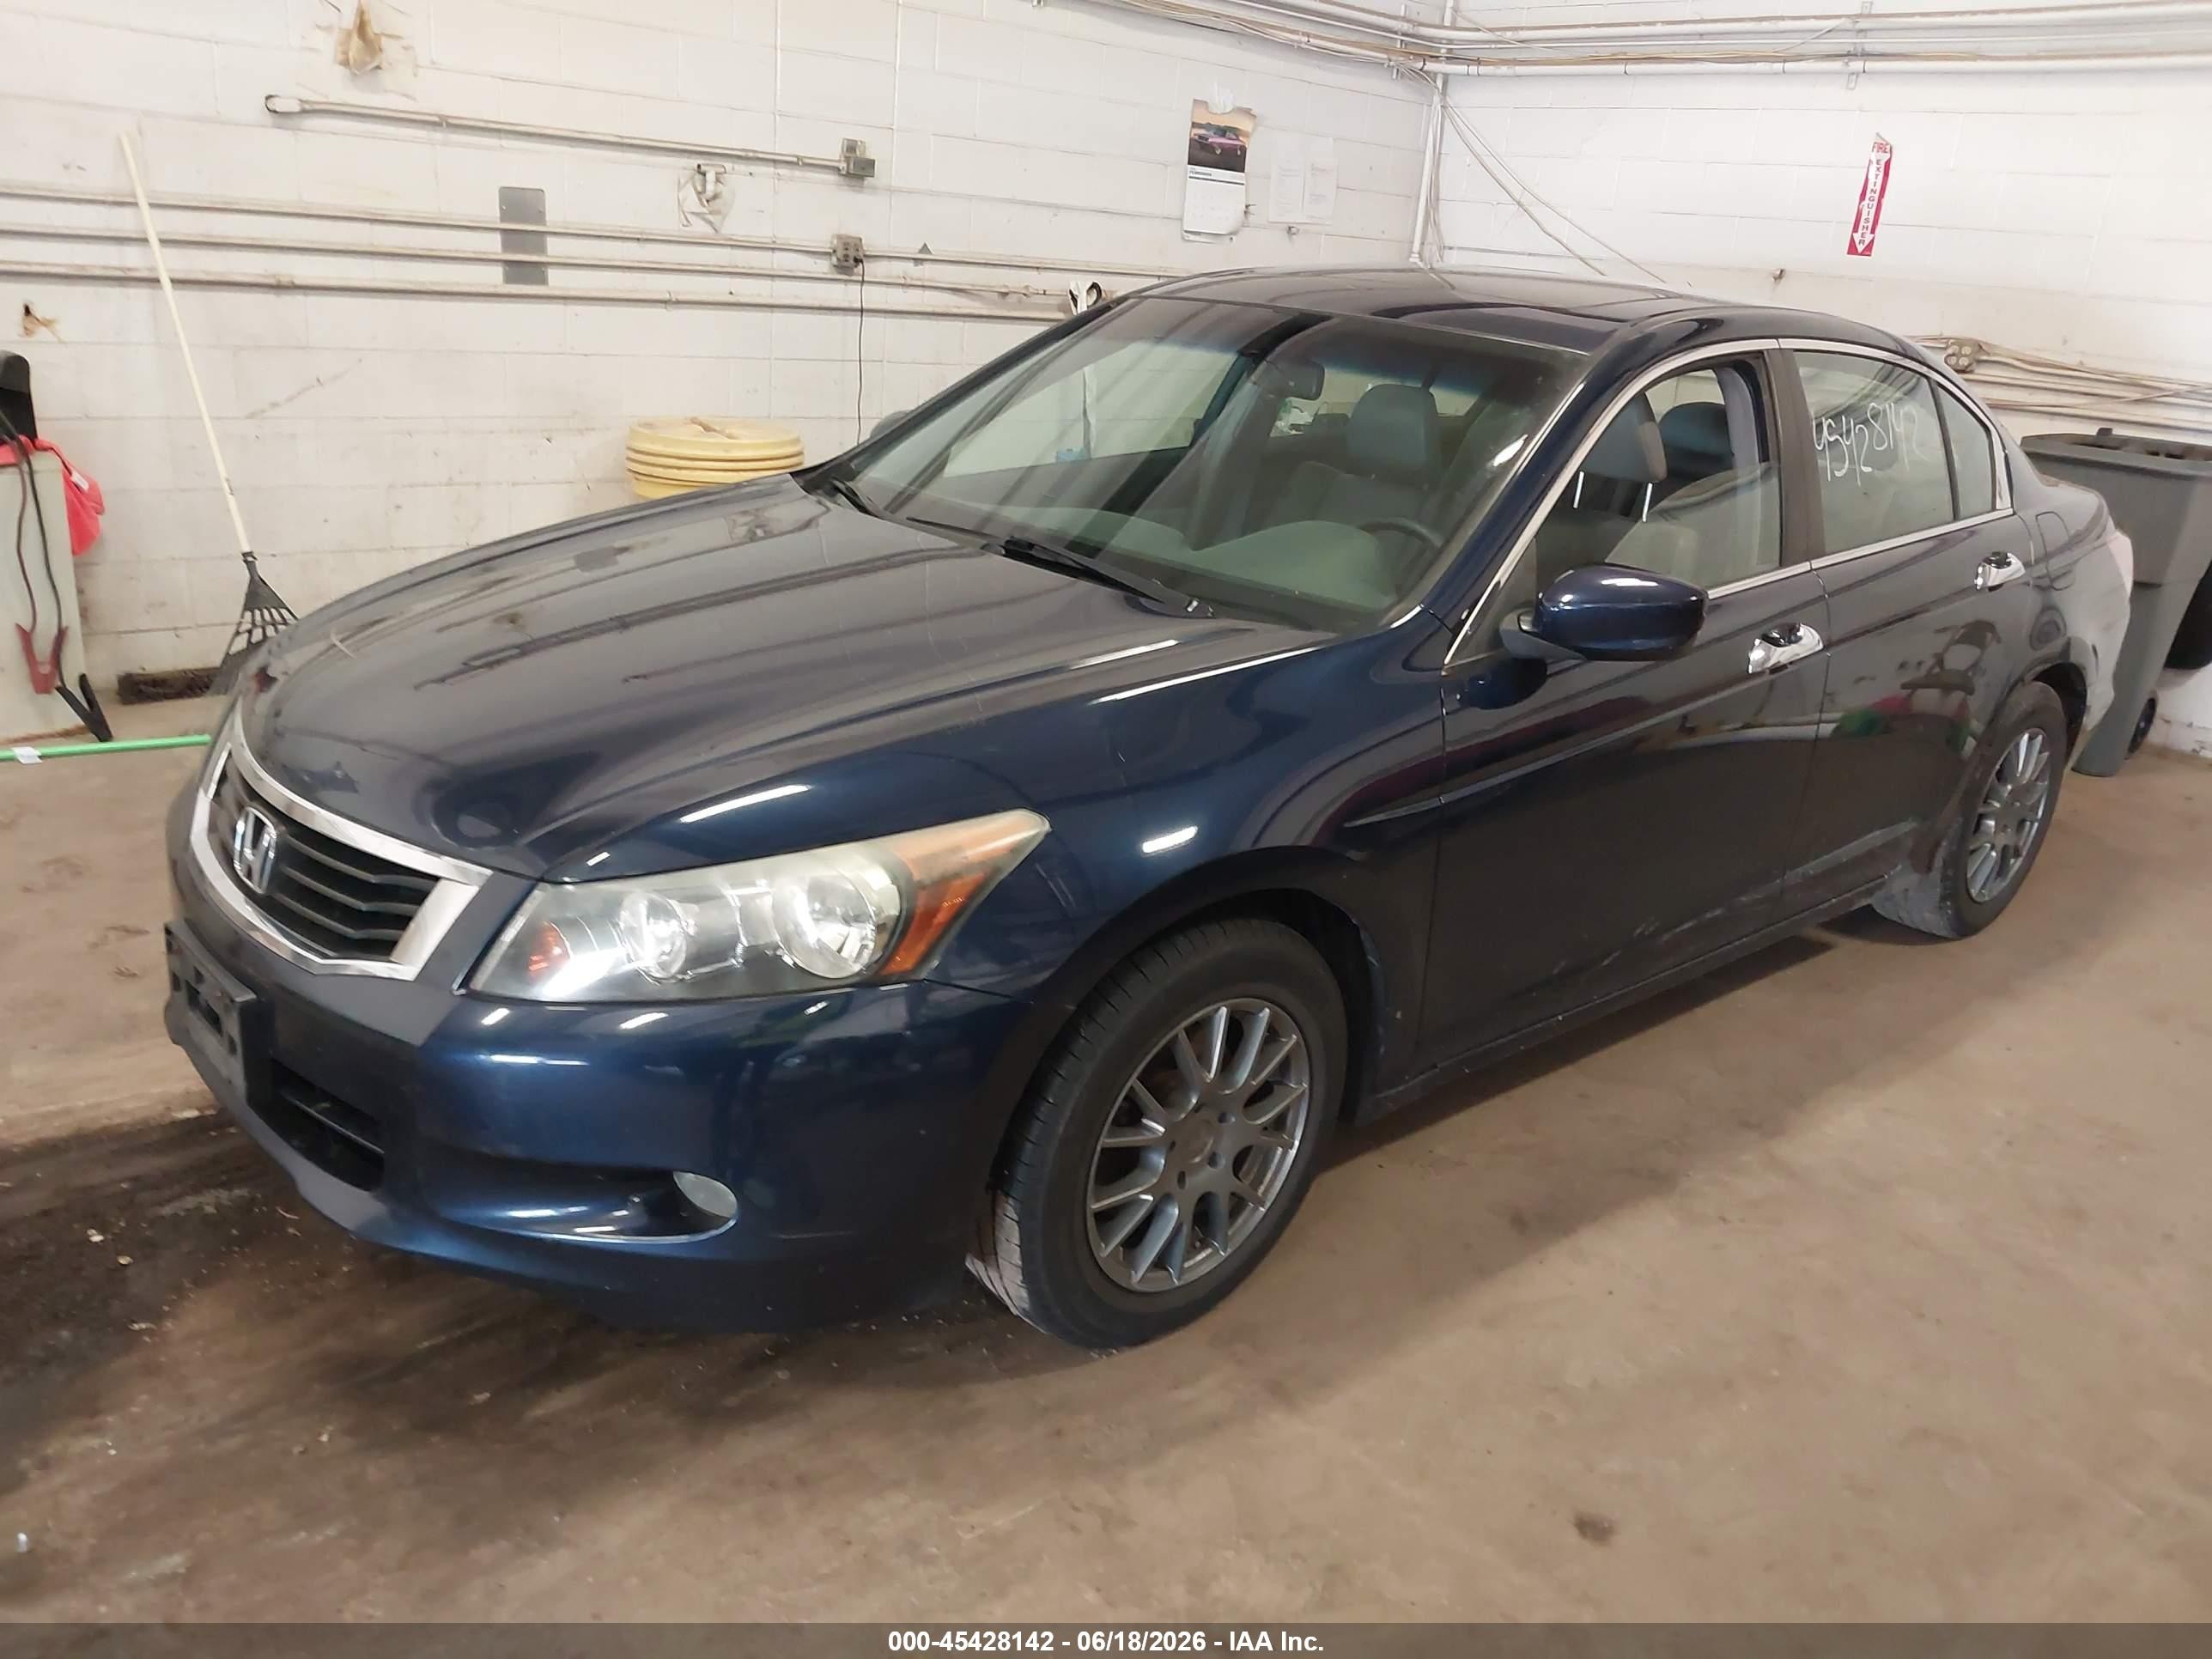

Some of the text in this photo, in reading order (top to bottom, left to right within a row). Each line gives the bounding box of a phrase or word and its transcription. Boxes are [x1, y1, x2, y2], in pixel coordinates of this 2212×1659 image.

[1872, 141, 1890, 154] FIRE
[1857, 158, 1882, 246] EXTINGUISHER
[1812, 402, 1930, 487] 45428142
